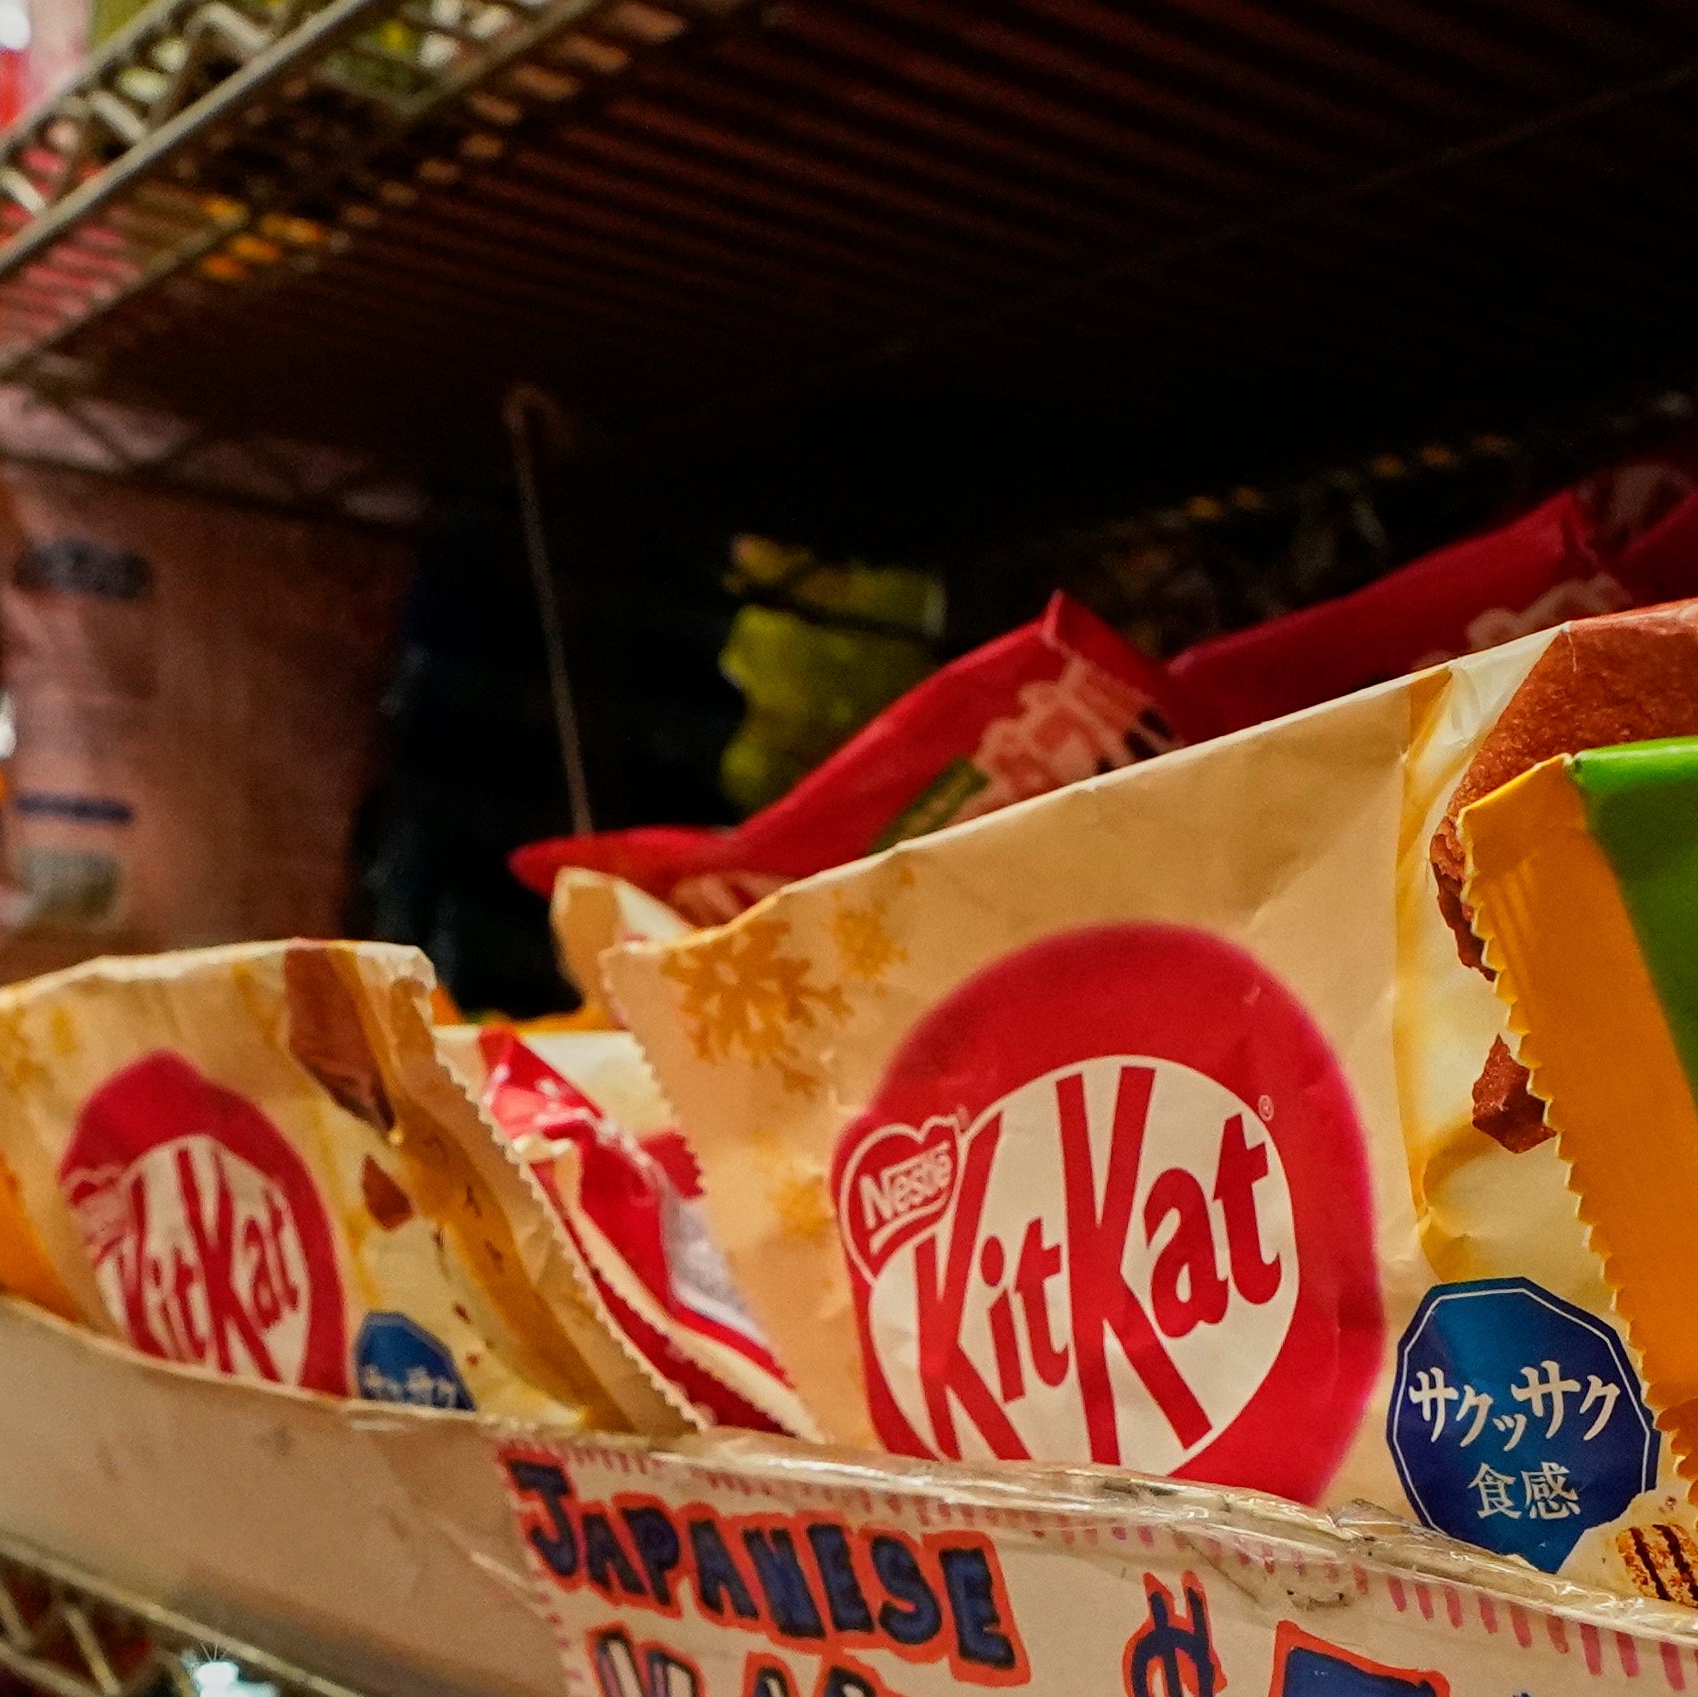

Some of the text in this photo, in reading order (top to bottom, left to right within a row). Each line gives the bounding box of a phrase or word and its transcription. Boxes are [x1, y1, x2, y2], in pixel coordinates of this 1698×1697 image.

[915, 1066, 1283, 1467] KitKat
[1408, 1359, 1621, 1452] サクッサク
[503, 1452, 1029, 1684] JAPANESE
[1467, 1461, 1582, 1520] 食感
